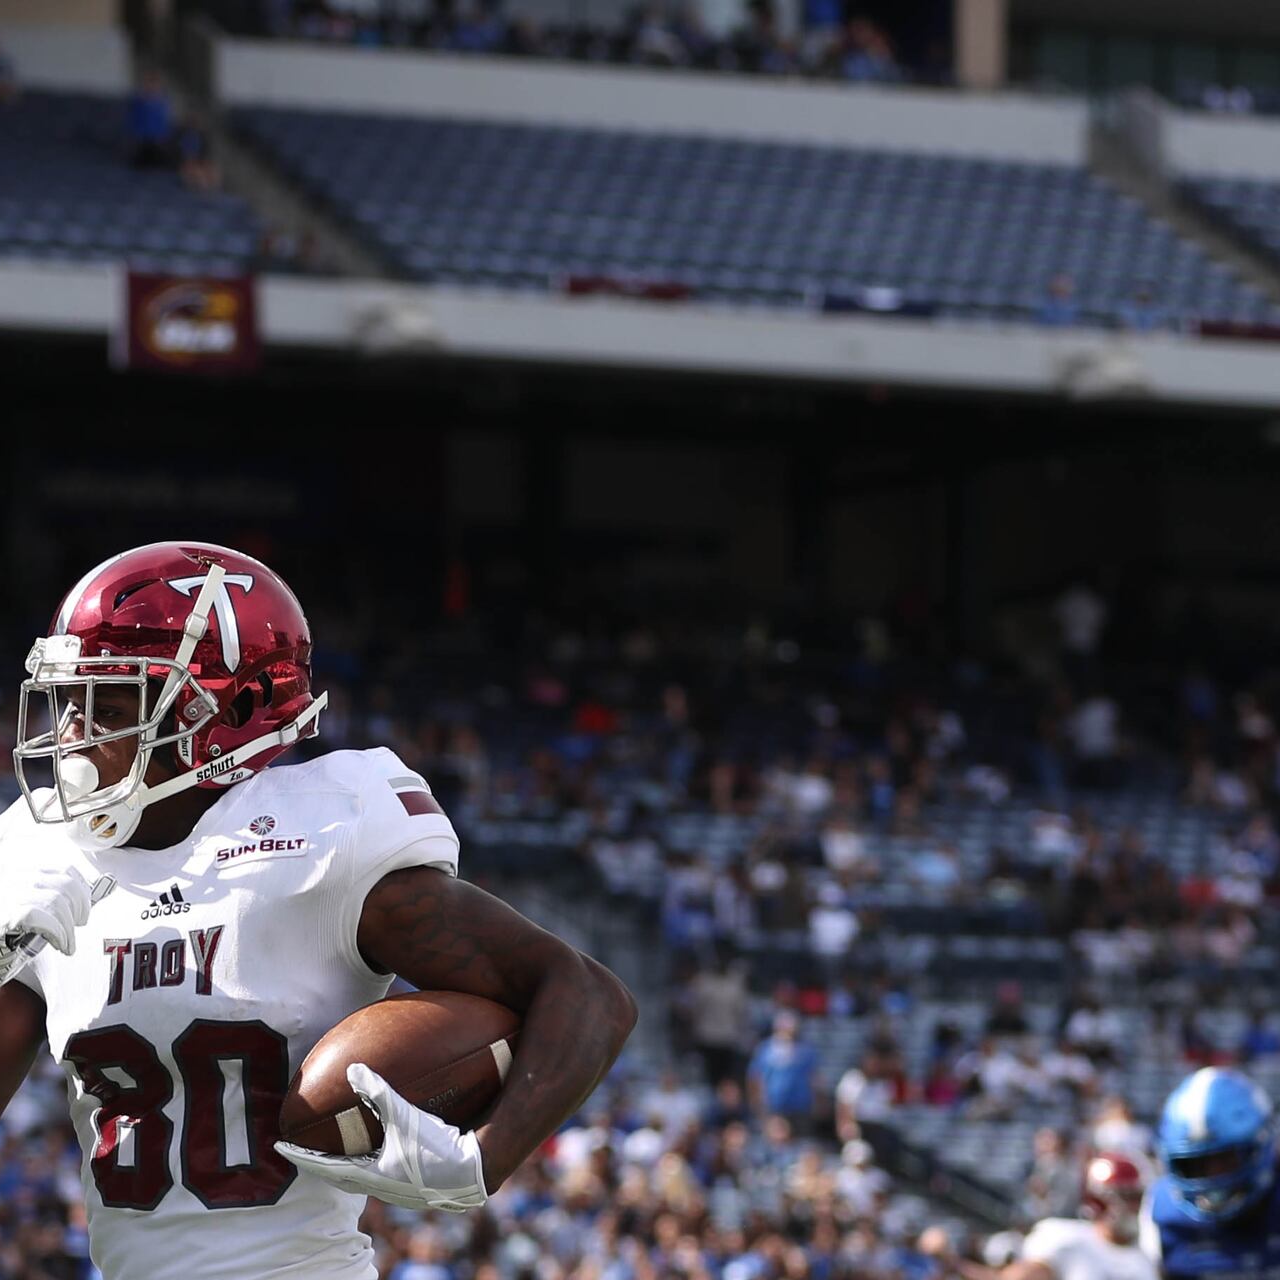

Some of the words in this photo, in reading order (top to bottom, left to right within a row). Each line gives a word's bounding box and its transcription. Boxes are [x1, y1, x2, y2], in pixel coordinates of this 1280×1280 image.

[196, 755, 235, 782] schutt
[140, 902, 192, 920] adidas
[103, 924, 225, 1006] TROY
[62, 1018, 299, 1212] 80
